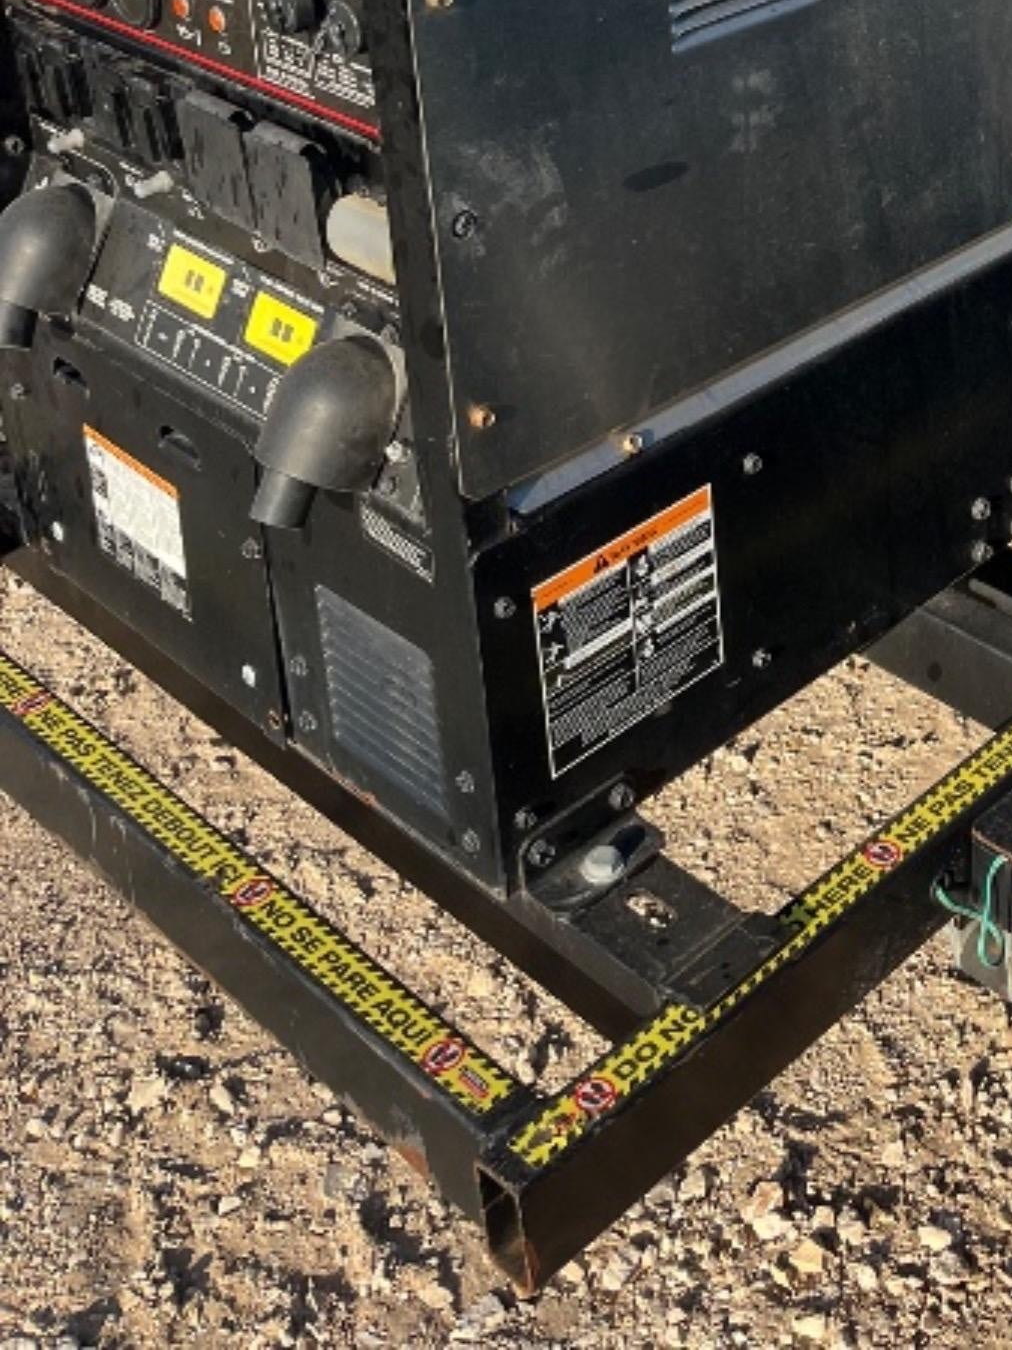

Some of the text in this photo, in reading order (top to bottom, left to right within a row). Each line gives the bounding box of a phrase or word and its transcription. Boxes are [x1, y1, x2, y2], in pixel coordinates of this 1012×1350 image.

[38, 708, 244, 886] NE PAS TENEZ DEBOUT ICI
[896, 816, 932, 845] NE
[930, 777, 977, 814] PAS
[261, 898, 297, 930] NO
[291, 926, 325, 955] SE
[319, 951, 383, 1002] PARE
[613, 1039, 659, 1081] DO
[659, 1007, 701, 1042] NO
